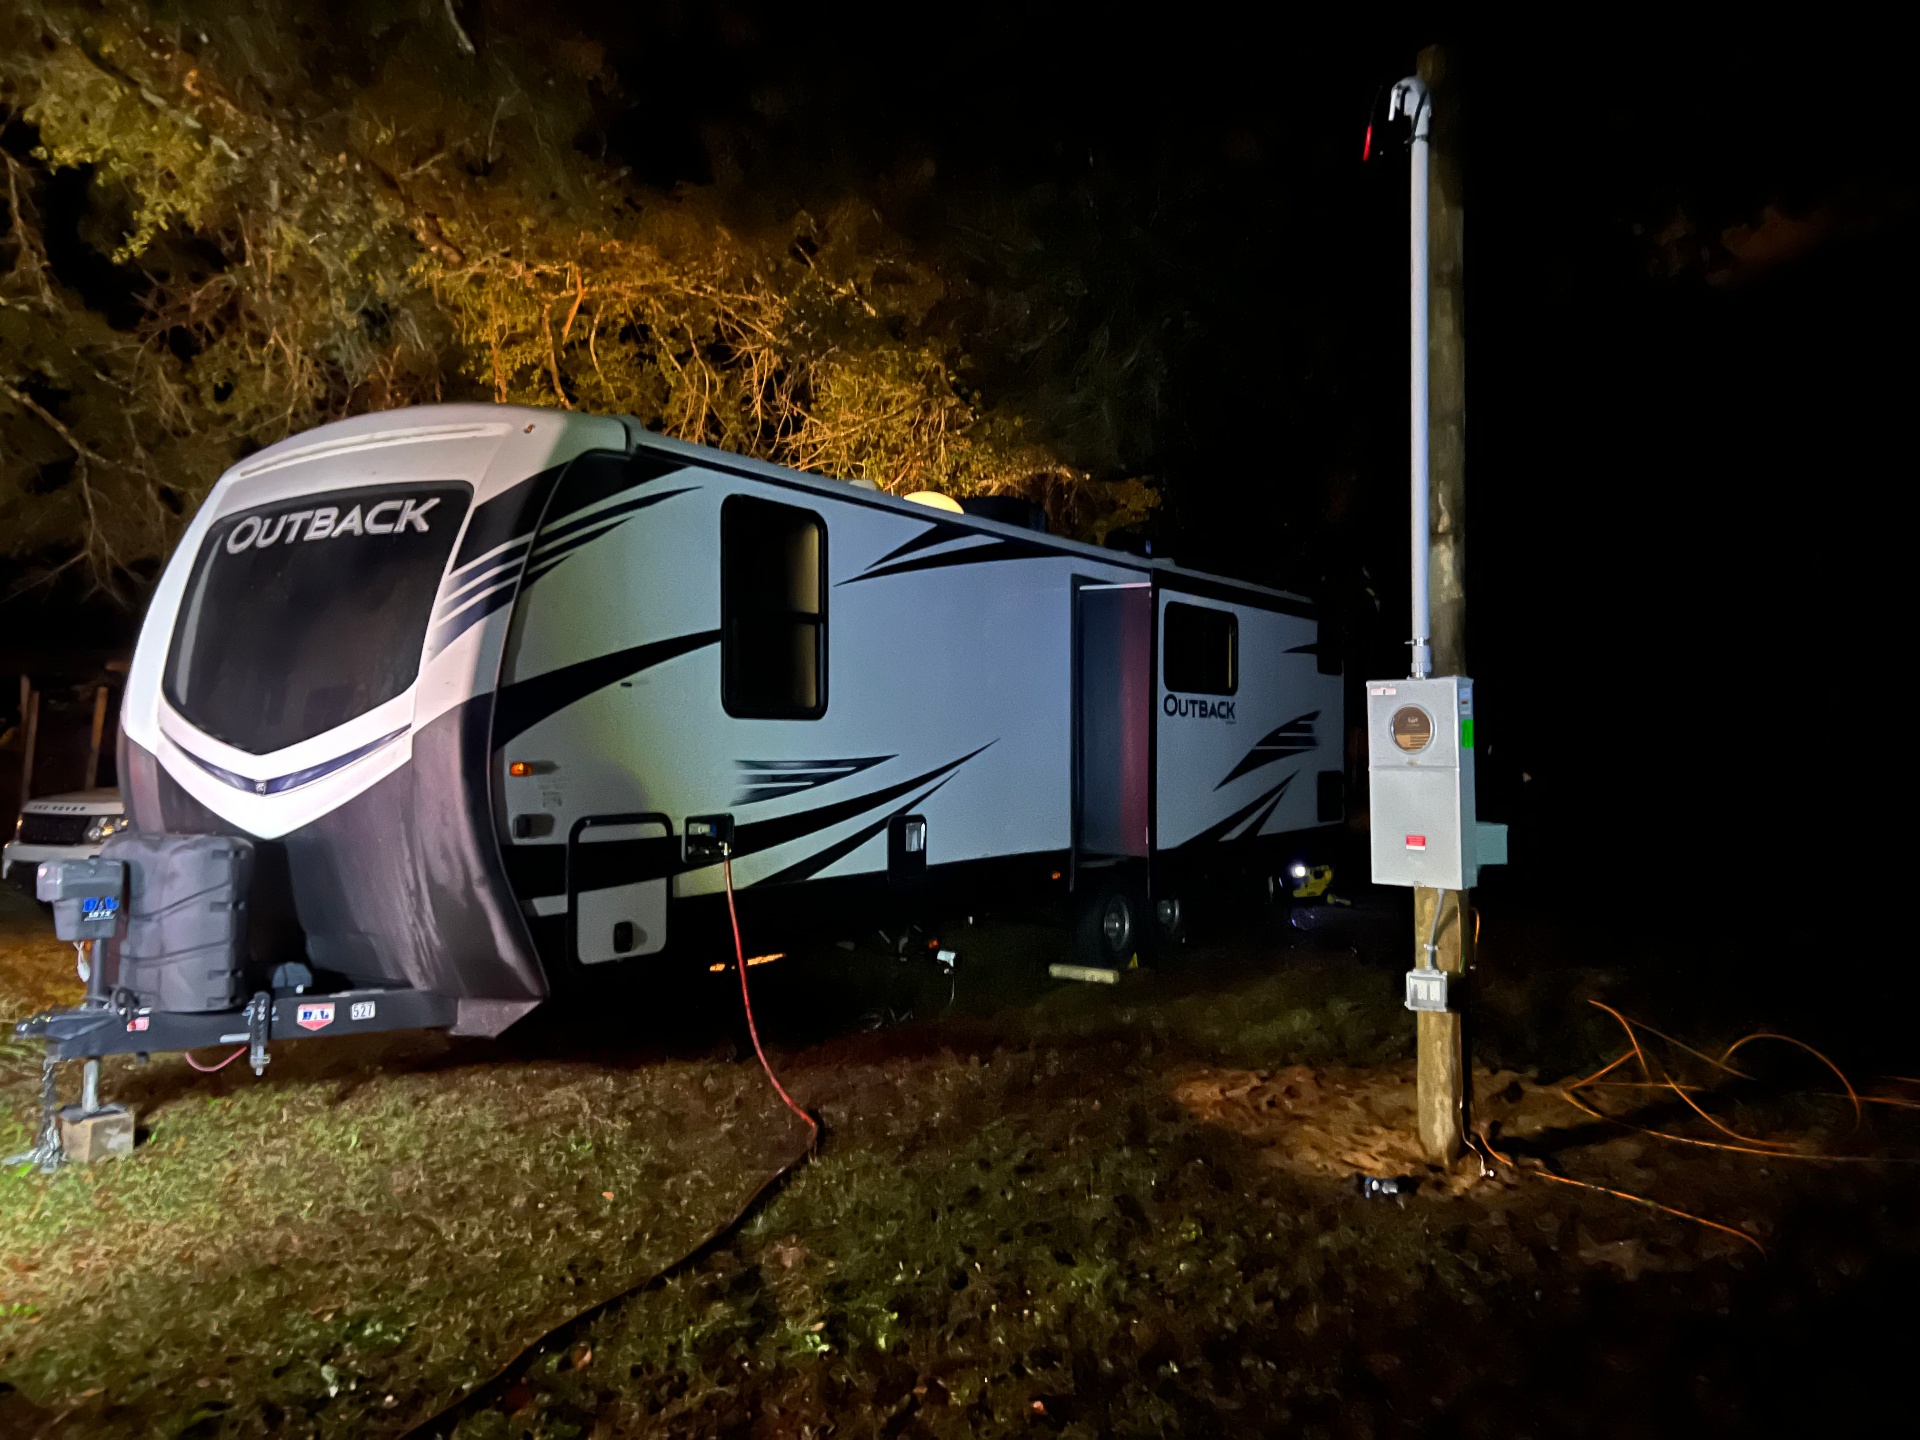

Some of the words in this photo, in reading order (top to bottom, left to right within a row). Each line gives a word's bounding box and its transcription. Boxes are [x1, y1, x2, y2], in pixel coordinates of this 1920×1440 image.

[226, 497, 441, 554] OUTBACK
[1163, 693, 1236, 720] OUTBACK
[353, 1005, 373, 1018] 527
